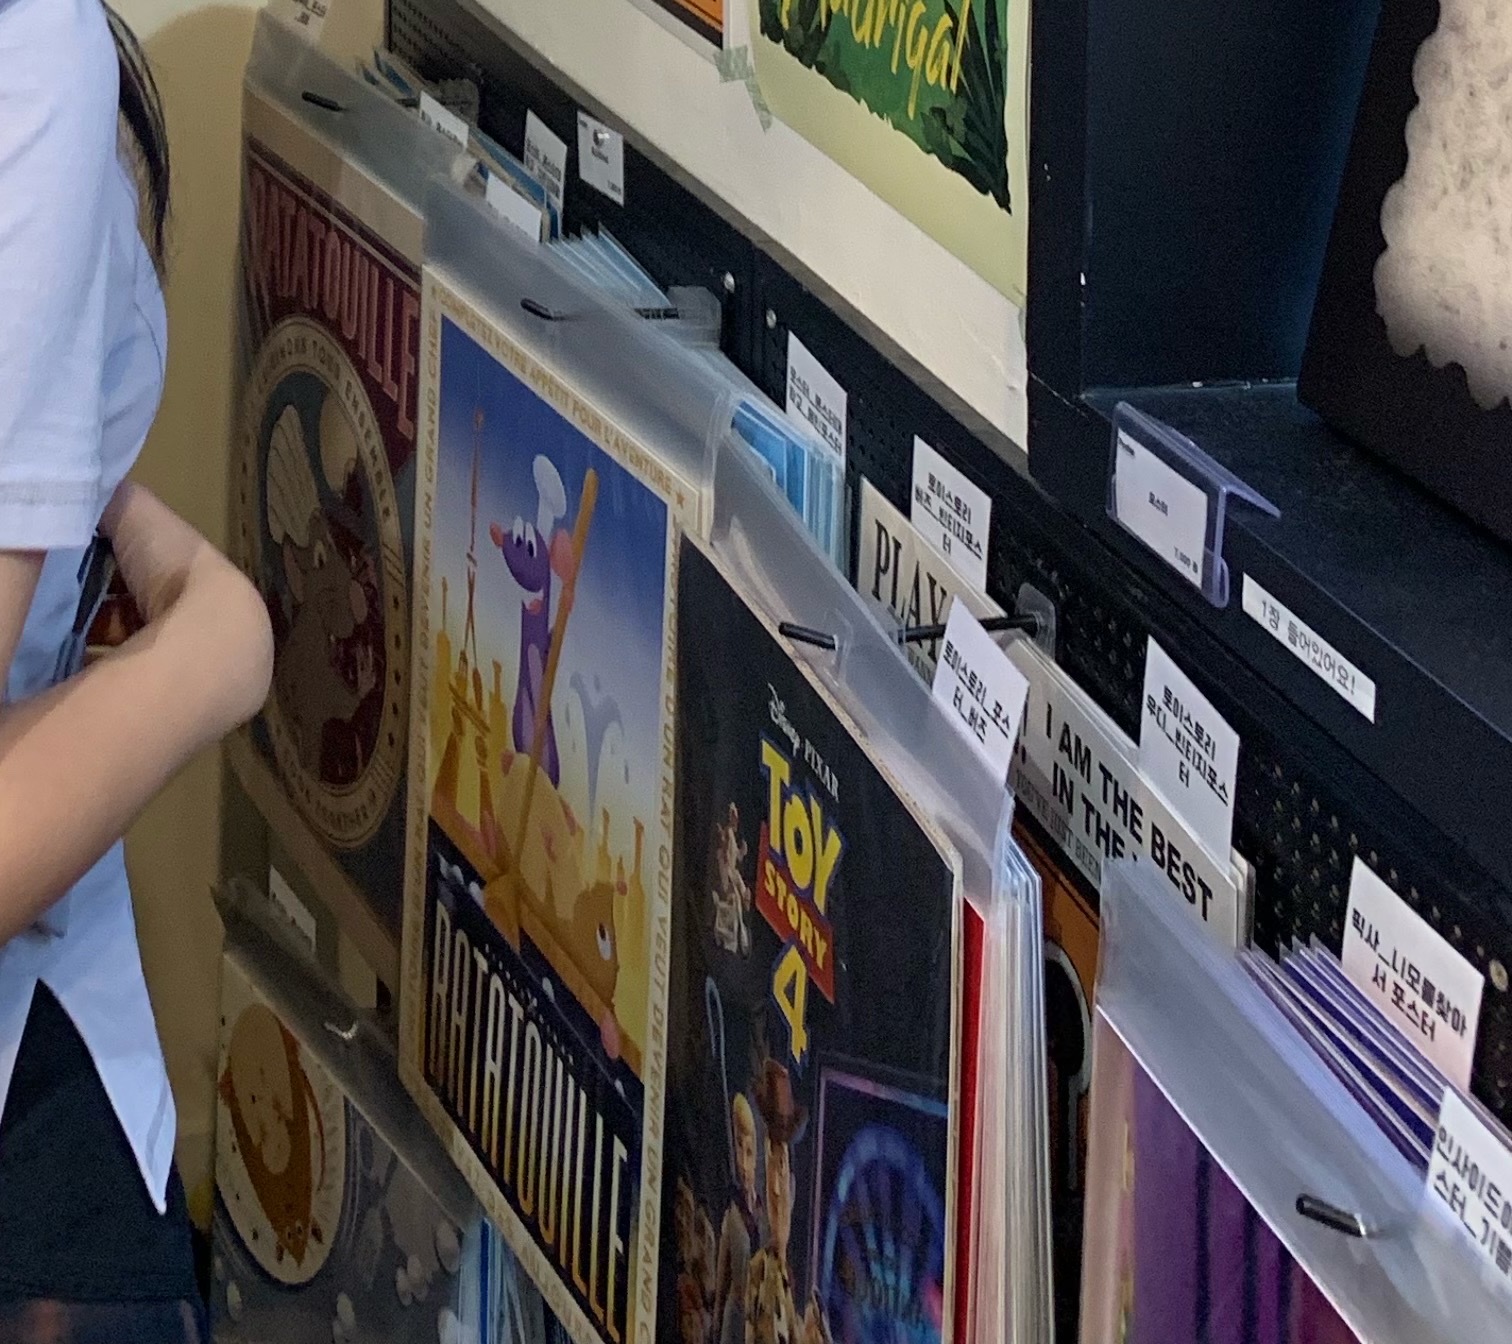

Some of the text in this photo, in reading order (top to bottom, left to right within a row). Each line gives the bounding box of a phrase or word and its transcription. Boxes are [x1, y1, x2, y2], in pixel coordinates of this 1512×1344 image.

[246, 157, 418, 442] RATATOUILLE
[422, 382, 436, 486] GRAND
[421, 488, 433, 532] UN
[928, 472, 971, 525] 토이스토리
[942, 533, 952, 554] 터
[872, 518, 947, 664] PLAY
[1262, 599, 1356, 695] 1장 들어있어요!
[803, 737, 839, 803] PIXAR
[1147, 694, 1229, 807] 우디_빈티지포스
[1162, 684, 1216, 762] 토이스토리
[1046, 701, 1213, 921] I AM THE BEST
[1053, 761, 1074, 816] IN
[1179, 760, 1189, 788] 터
[654, 842, 672, 904] QUI
[761, 737, 842, 916] TOY
[650, 915, 670, 996] VEUT
[764, 858, 828, 971] STORY
[773, 944, 808, 1065] 4
[1352, 907, 1467, 1037] 픽사_니모를찾아
[1372, 963, 1436, 1042] 서 포스터
[427, 898, 628, 1343] RATATOUILLE
[642, 1003, 668, 1139] DEVENIR
[643, 1144, 660, 1194] UN
[637, 1198, 658, 1313] GRAND
